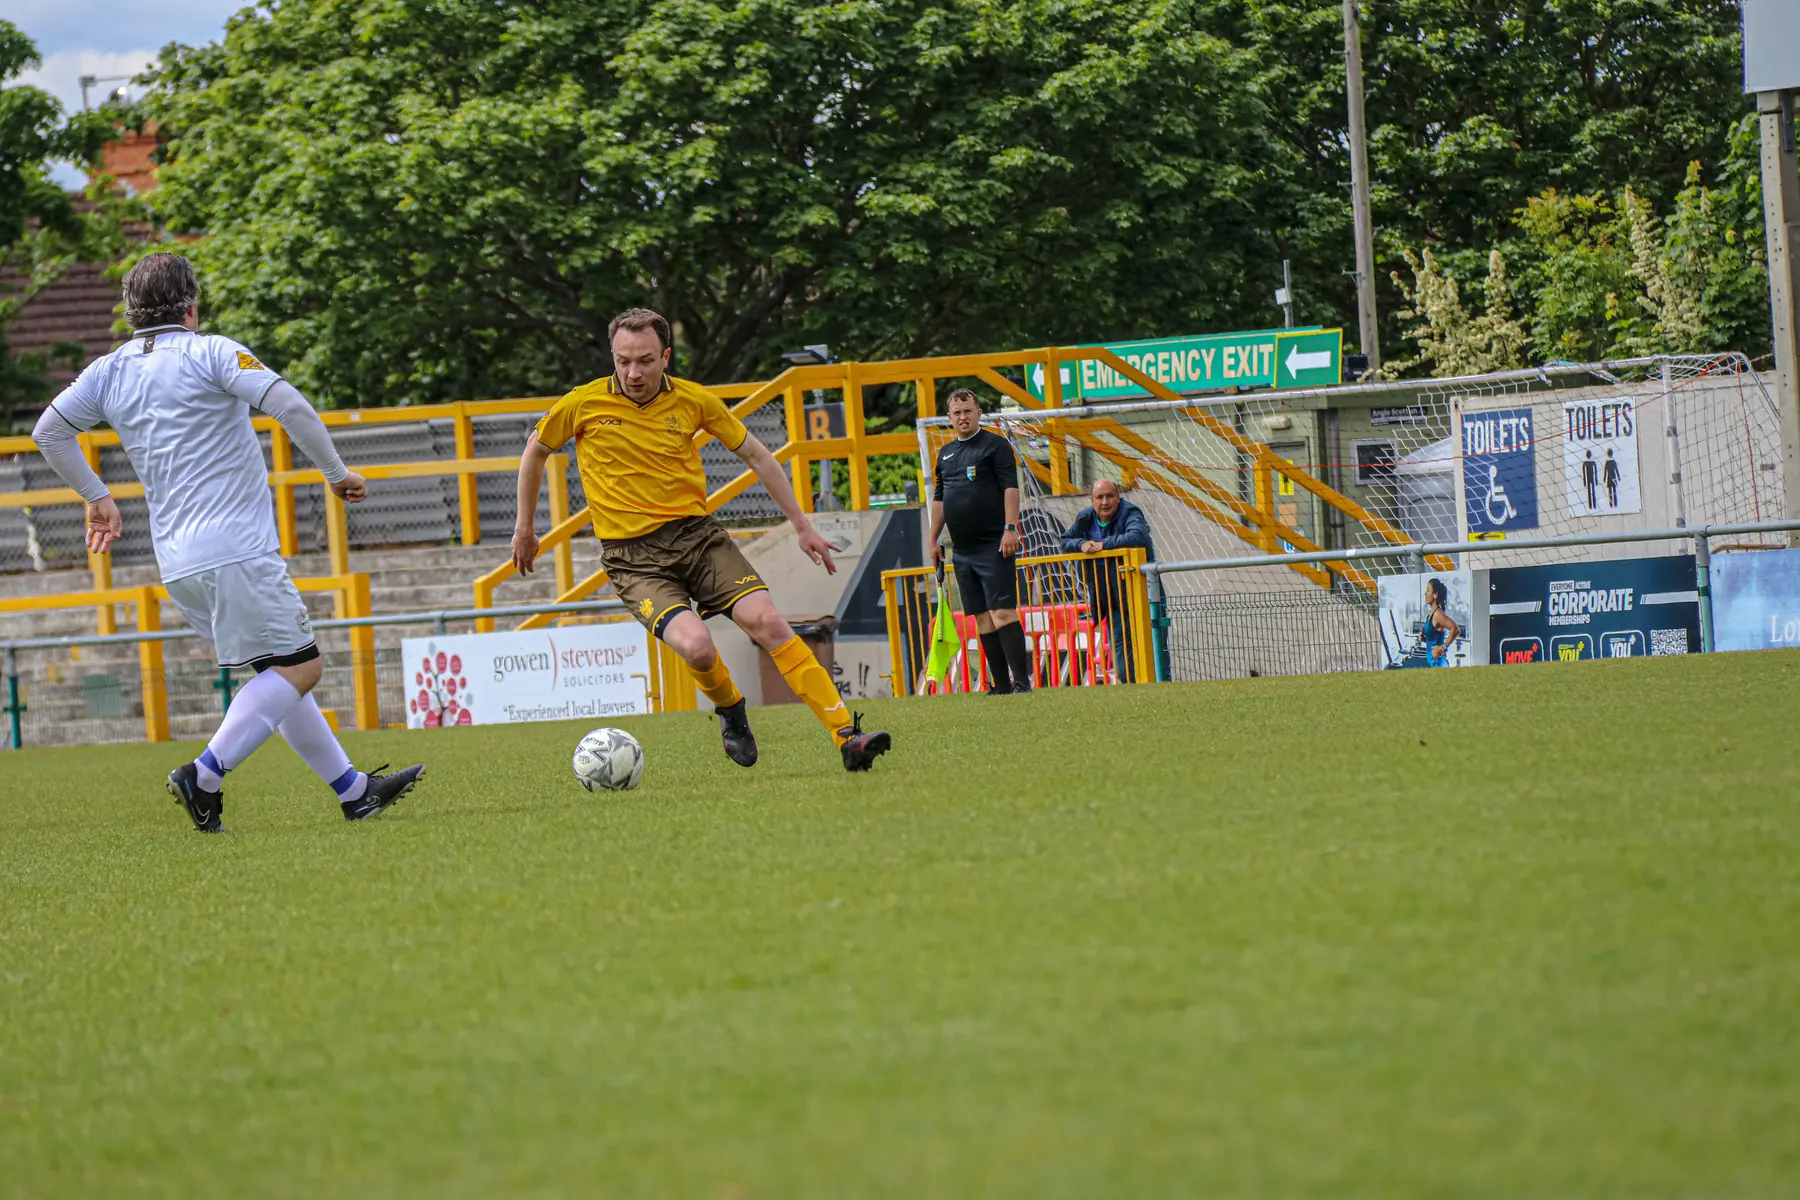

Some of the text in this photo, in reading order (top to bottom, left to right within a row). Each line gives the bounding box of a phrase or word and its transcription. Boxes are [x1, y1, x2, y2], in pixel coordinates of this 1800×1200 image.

[1223, 343, 1274, 378] EXIT
[1566, 402, 1633, 441] TOILETS
[1464, 417, 1530, 455] TOILETS
[734, 575, 758, 585] VX3
[1549, 588, 1633, 616] CORPORATE
[1549, 614, 1590, 626] MEMBERSHIPS
[1506, 650, 1534, 664] MOVE
[1558, 648, 1579, 661] YOU
[1610, 642, 1631, 658] YOU
[493, 652, 549, 683] gowen
[561, 647, 624, 669] stevens
[564, 673, 625, 688] SOLICITORS
[572, 699, 595, 716] local
[597, 698, 636, 714] lawyers
